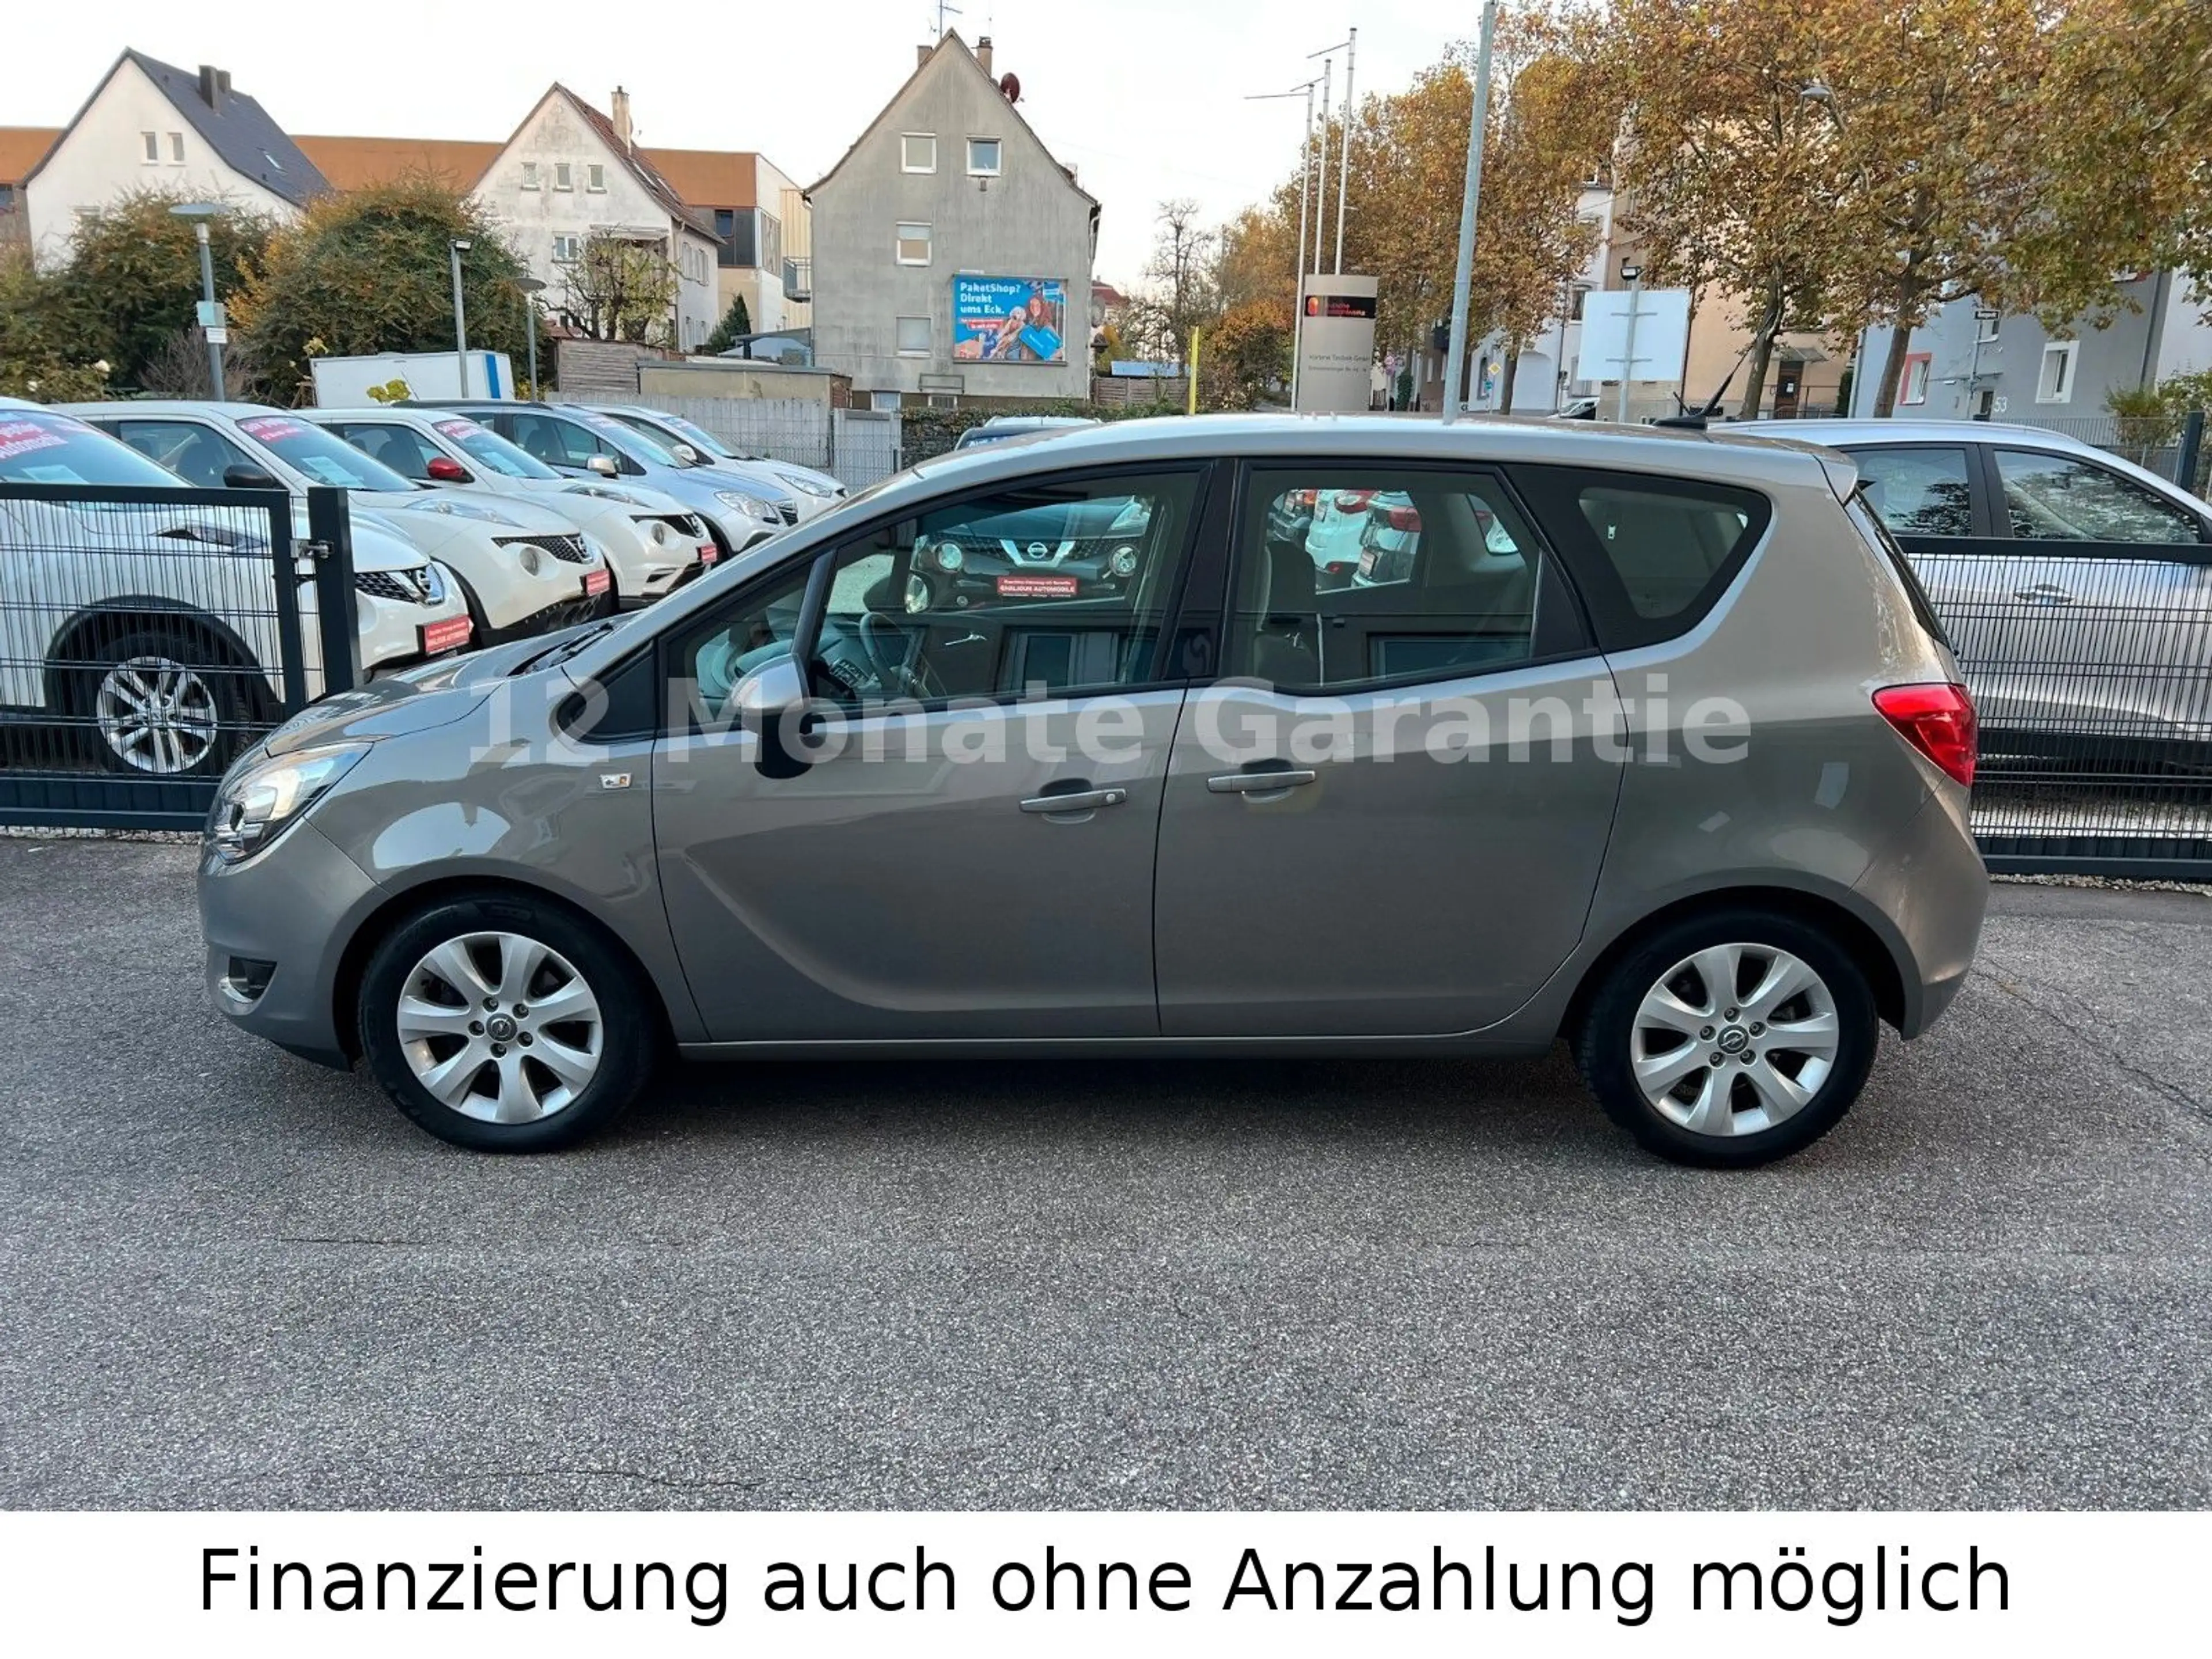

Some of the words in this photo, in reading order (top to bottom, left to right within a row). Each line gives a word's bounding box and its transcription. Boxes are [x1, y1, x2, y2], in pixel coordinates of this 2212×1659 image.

[960, 282, 1021, 295] PaketShop?
[960, 293, 993, 303] Direkt
[960, 305, 982, 313] ums
[984, 304, 1005, 314] Eck.
[1994, 396, 2008, 413] 53
